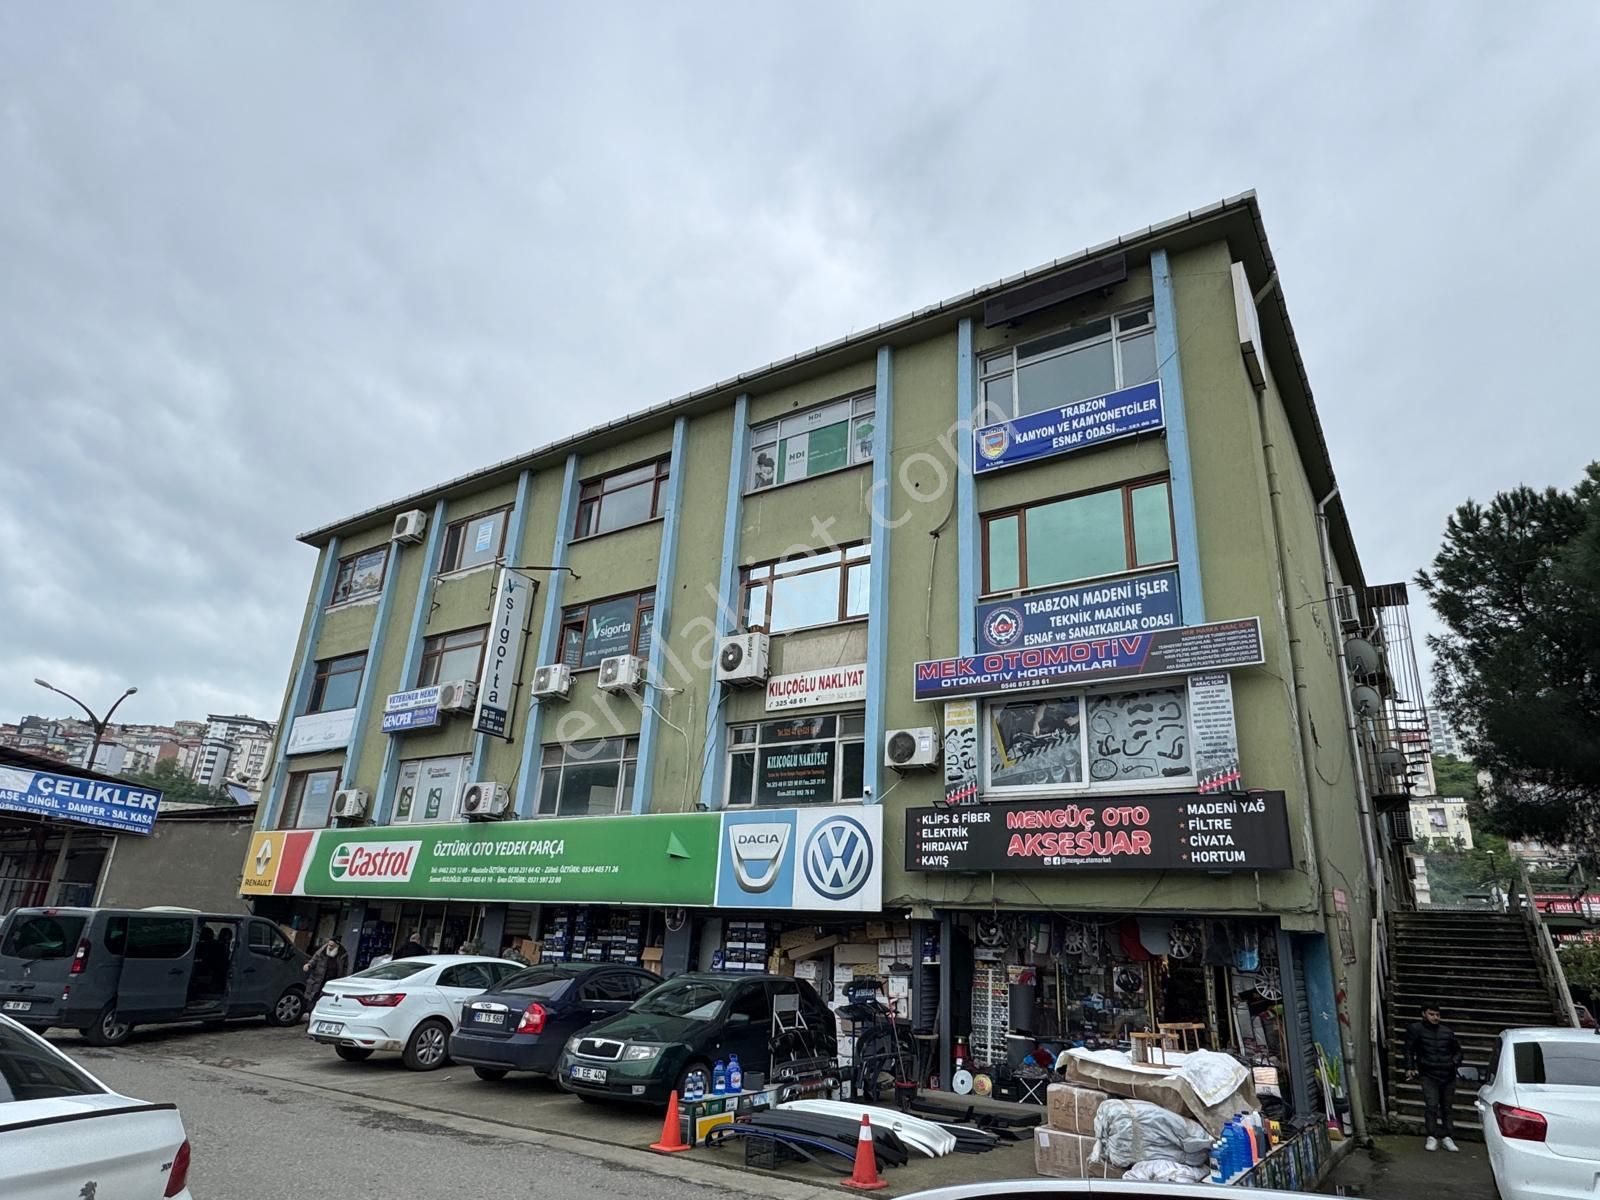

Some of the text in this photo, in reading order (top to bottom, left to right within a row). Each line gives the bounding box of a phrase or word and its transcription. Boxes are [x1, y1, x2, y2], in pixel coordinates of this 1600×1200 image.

[808, 412, 822, 421] HDI
[1061, 398, 1106, 419] TRABZON
[1016, 425, 1055, 444] KAMYON
[1057, 422, 1070, 434] VE
[1072, 398, 1156, 430] KAMYONETCİLER
[1052, 432, 1084, 448] ESNAF
[1087, 423, 1116, 440] ODASI
[789, 450, 805, 460] HDI
[1024, 579, 1168, 616] TRABZON MADENİ İŞLER
[1050, 602, 1143, 628] TEKNİK MAKİNE
[1024, 613, 1174, 646] ESNAF ve SANATKARLAR ODASI
[918, 636, 1142, 680] MEK OTOMOTİV
[1018, 659, 1117, 678] HORTUMLARI
[768, 669, 864, 699] KILIÇOĞLU NAKLİYAT
[37, 777, 157, 810] ÇELİKLER
[28, 794, 60, 808] DİNGİL
[68, 802, 105, 816] DAMPER
[112, 810, 128, 820] SAL
[130, 812, 152, 824] KASA
[1187, 798, 1266, 814] MADENİ YAĞ
[922, 811, 991, 824] KLİPS & FİBER
[1006, 805, 1150, 831] MENGÜÇ OTO
[1188, 818, 1232, 831] FİLTRE
[738, 834, 780, 844] DACIA
[922, 825, 968, 838] ELEKTRİK
[1190, 833, 1234, 847] CİVATA
[433, 840, 564, 858] ÖZTÜRK OTO YEDEK PARÇA
[922, 840, 968, 852] HIRDAVAT
[1006, 832, 1152, 856] AKSESUAR
[348, 846, 414, 876] Castrol
[921, 854, 949, 867] KAYIŞ
[1191, 850, 1246, 863] HORTUM
[245, 878, 272, 888] RENAULT
[583, 1069, 591, 1078] EE
